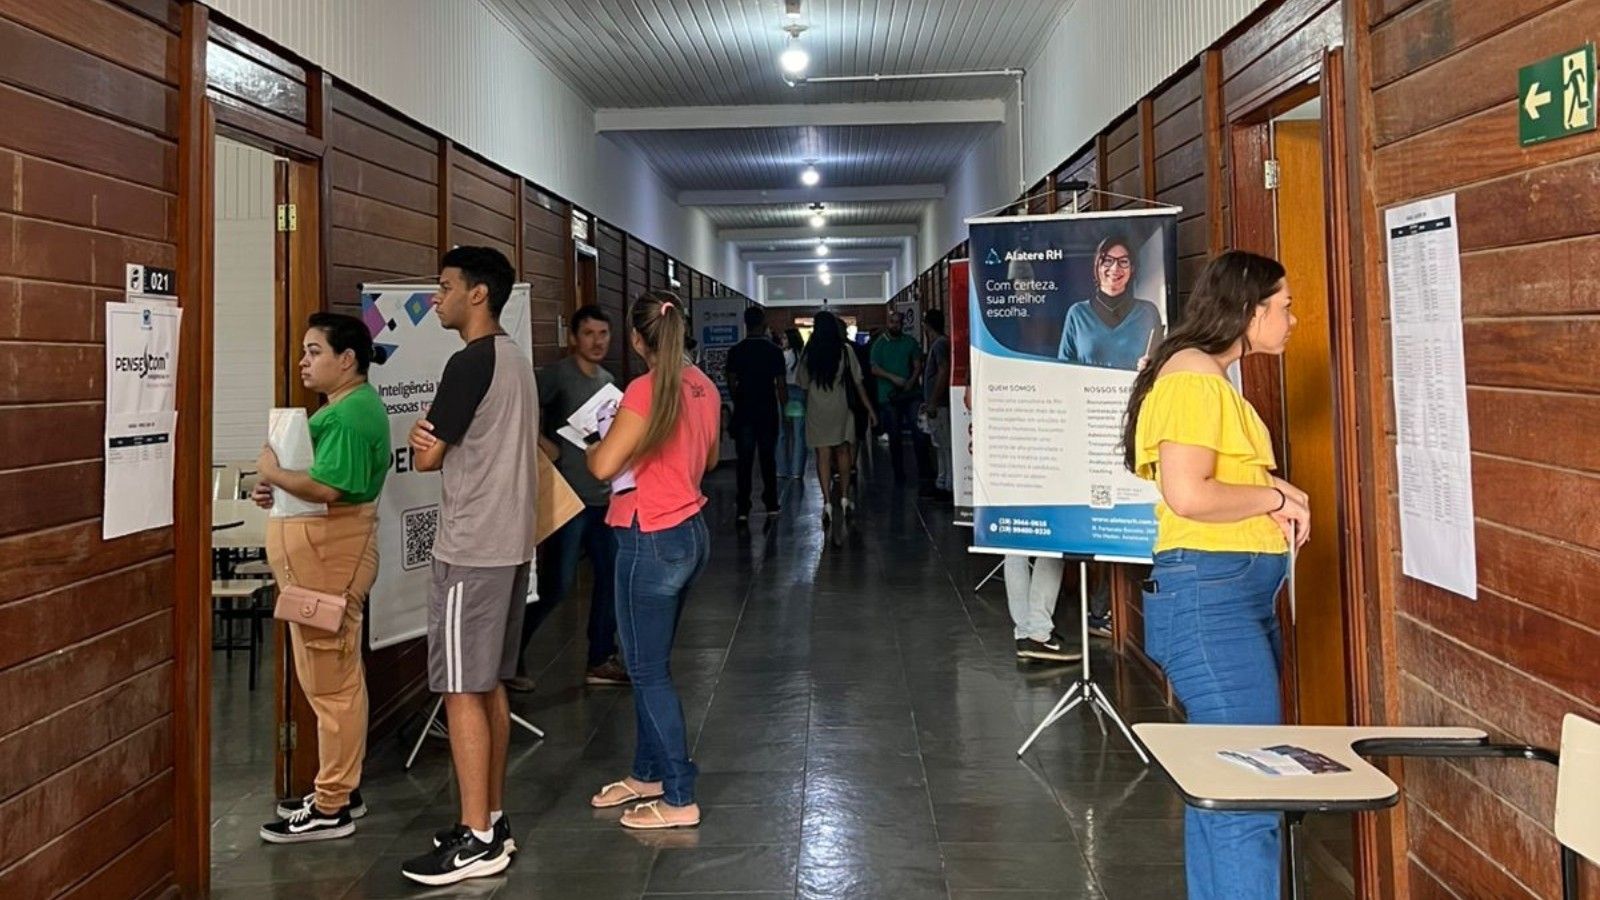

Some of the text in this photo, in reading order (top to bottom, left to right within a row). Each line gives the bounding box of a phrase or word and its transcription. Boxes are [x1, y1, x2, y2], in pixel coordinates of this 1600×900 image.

[1005, 249, 1063, 262] Alatere RH
[150, 271, 169, 291] 021
[985, 279, 1058, 291] Com certeza,
[986, 292, 1046, 304] sua melhor
[986, 306, 1030, 318] escolha.
[378, 379, 435, 399] Inteligência
[988, 384, 1008, 392] QUEM
[1083, 386, 1117, 394] NOSSOS
[384, 400, 419, 415] essoas
